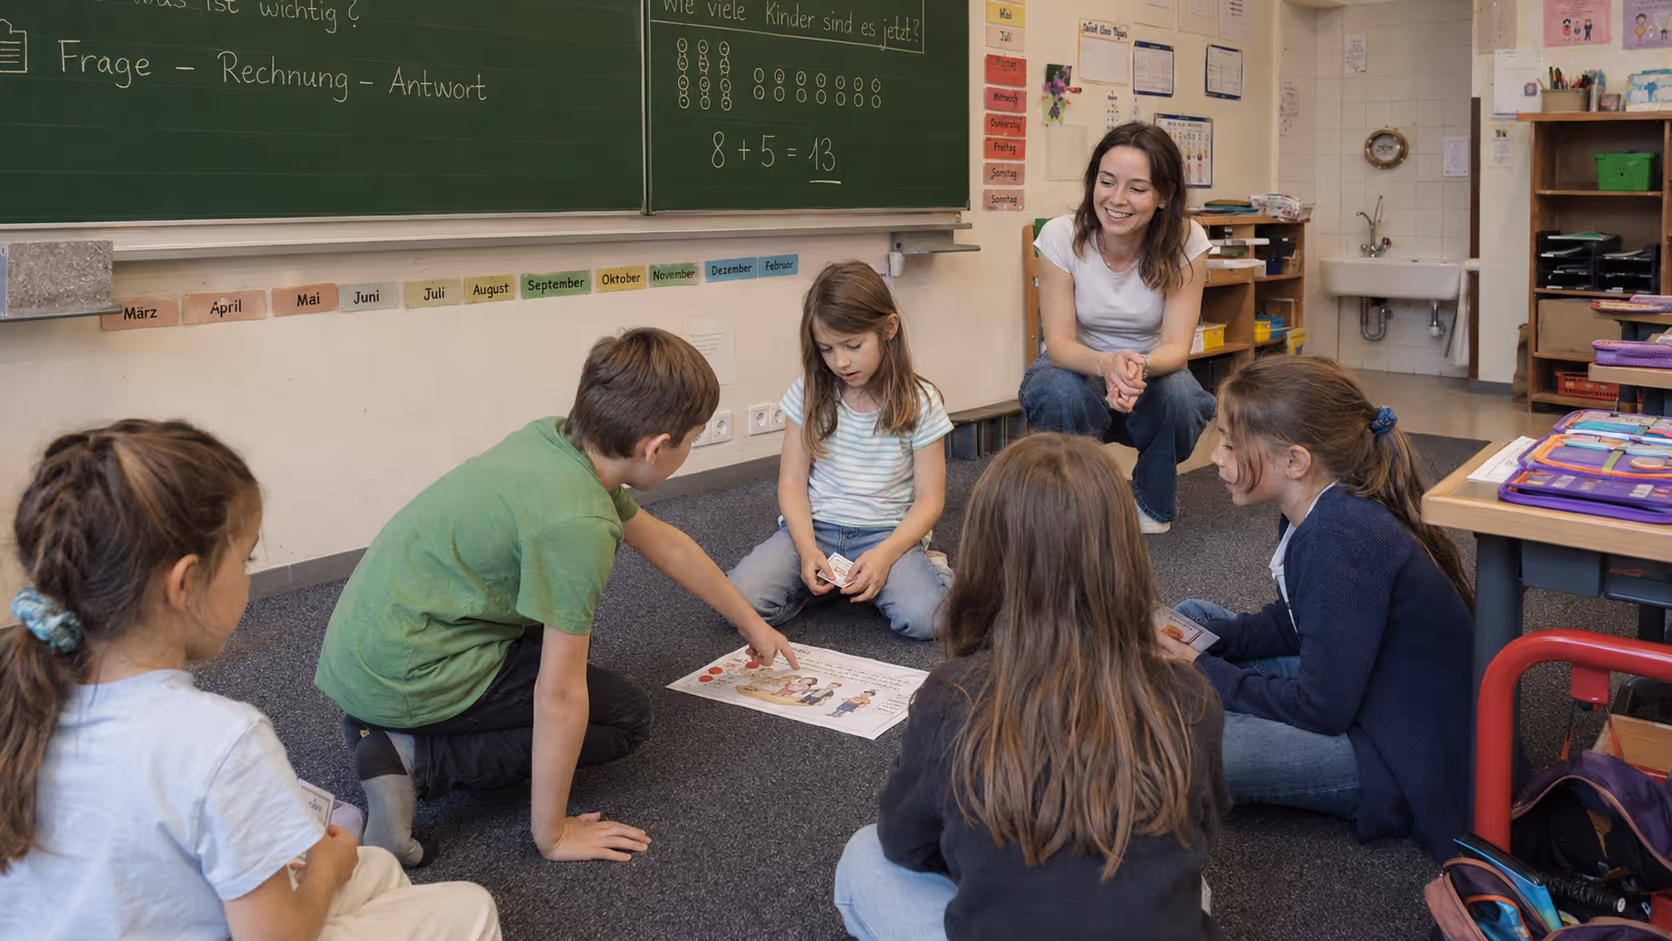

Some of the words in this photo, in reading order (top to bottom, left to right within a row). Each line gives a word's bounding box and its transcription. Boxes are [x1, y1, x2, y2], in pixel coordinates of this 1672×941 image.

[134, 0, 187, 8] as
[259, 0, 337, 34] wichtig
[347, 0, 360, 28] ?
[707, 0, 746, 21] viele
[766, 0, 815, 29] Kinder
[823, 10, 853, 34] sind
[861, 21, 876, 37] es
[879, 15, 920, 51] jetzt?
[999, 30, 1012, 42] Juli
[58, 39, 152, 89] Frage
[216, 50, 348, 103] Rechnung
[388, 66, 487, 101] Antwort
[711, 130, 726, 169] 8
[737, 139, 752, 161] +
[761, 134, 776, 168] 5
[808, 137, 836, 171] 13
[711, 263, 752, 276] Dezember
[765, 259, 794, 271] Februar
[601, 272, 641, 285] Oktober
[652, 269, 695, 281] November
[472, 282, 509, 298] August
[527, 277, 585, 294] September
[296, 291, 321, 307] Mai
[353, 289, 380, 304] Juni
[423, 287, 445, 301] Juli
[123, 305, 158, 321] März
[210, 299, 243, 318] April
